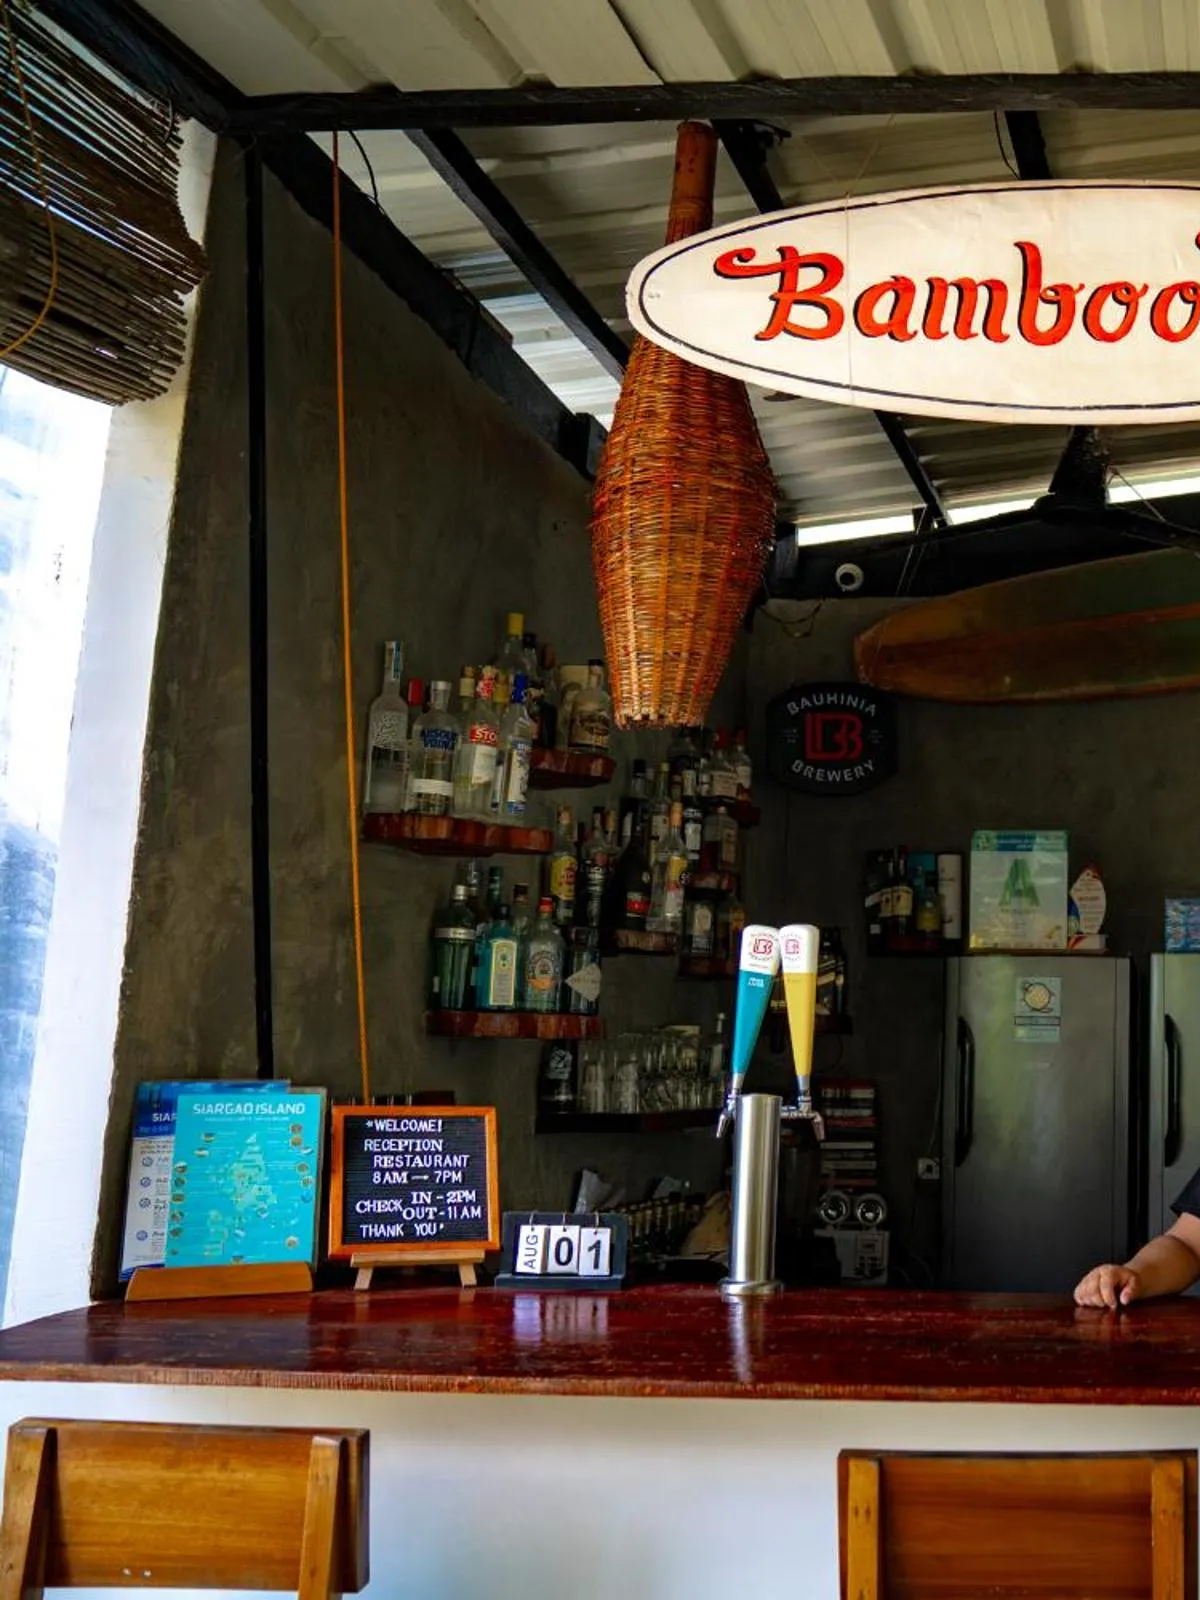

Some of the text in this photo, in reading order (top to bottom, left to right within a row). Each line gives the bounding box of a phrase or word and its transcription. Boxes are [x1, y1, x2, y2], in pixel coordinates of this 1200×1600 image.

[787, 692, 876, 717] BAUHINIA
[791, 759, 875, 783] BREWERY
[192, 1102, 306, 1116] SIARGAO ISLAND
[363, 1138, 444, 1152] RECEPTION
[373, 1154, 470, 1168] RESTAURANT
[434, 1170, 463, 1184] 7PM
[355, 1199, 403, 1215] CHECK
[359, 1224, 404, 1239] THANK
[523, 1233, 539, 1270] AUG
